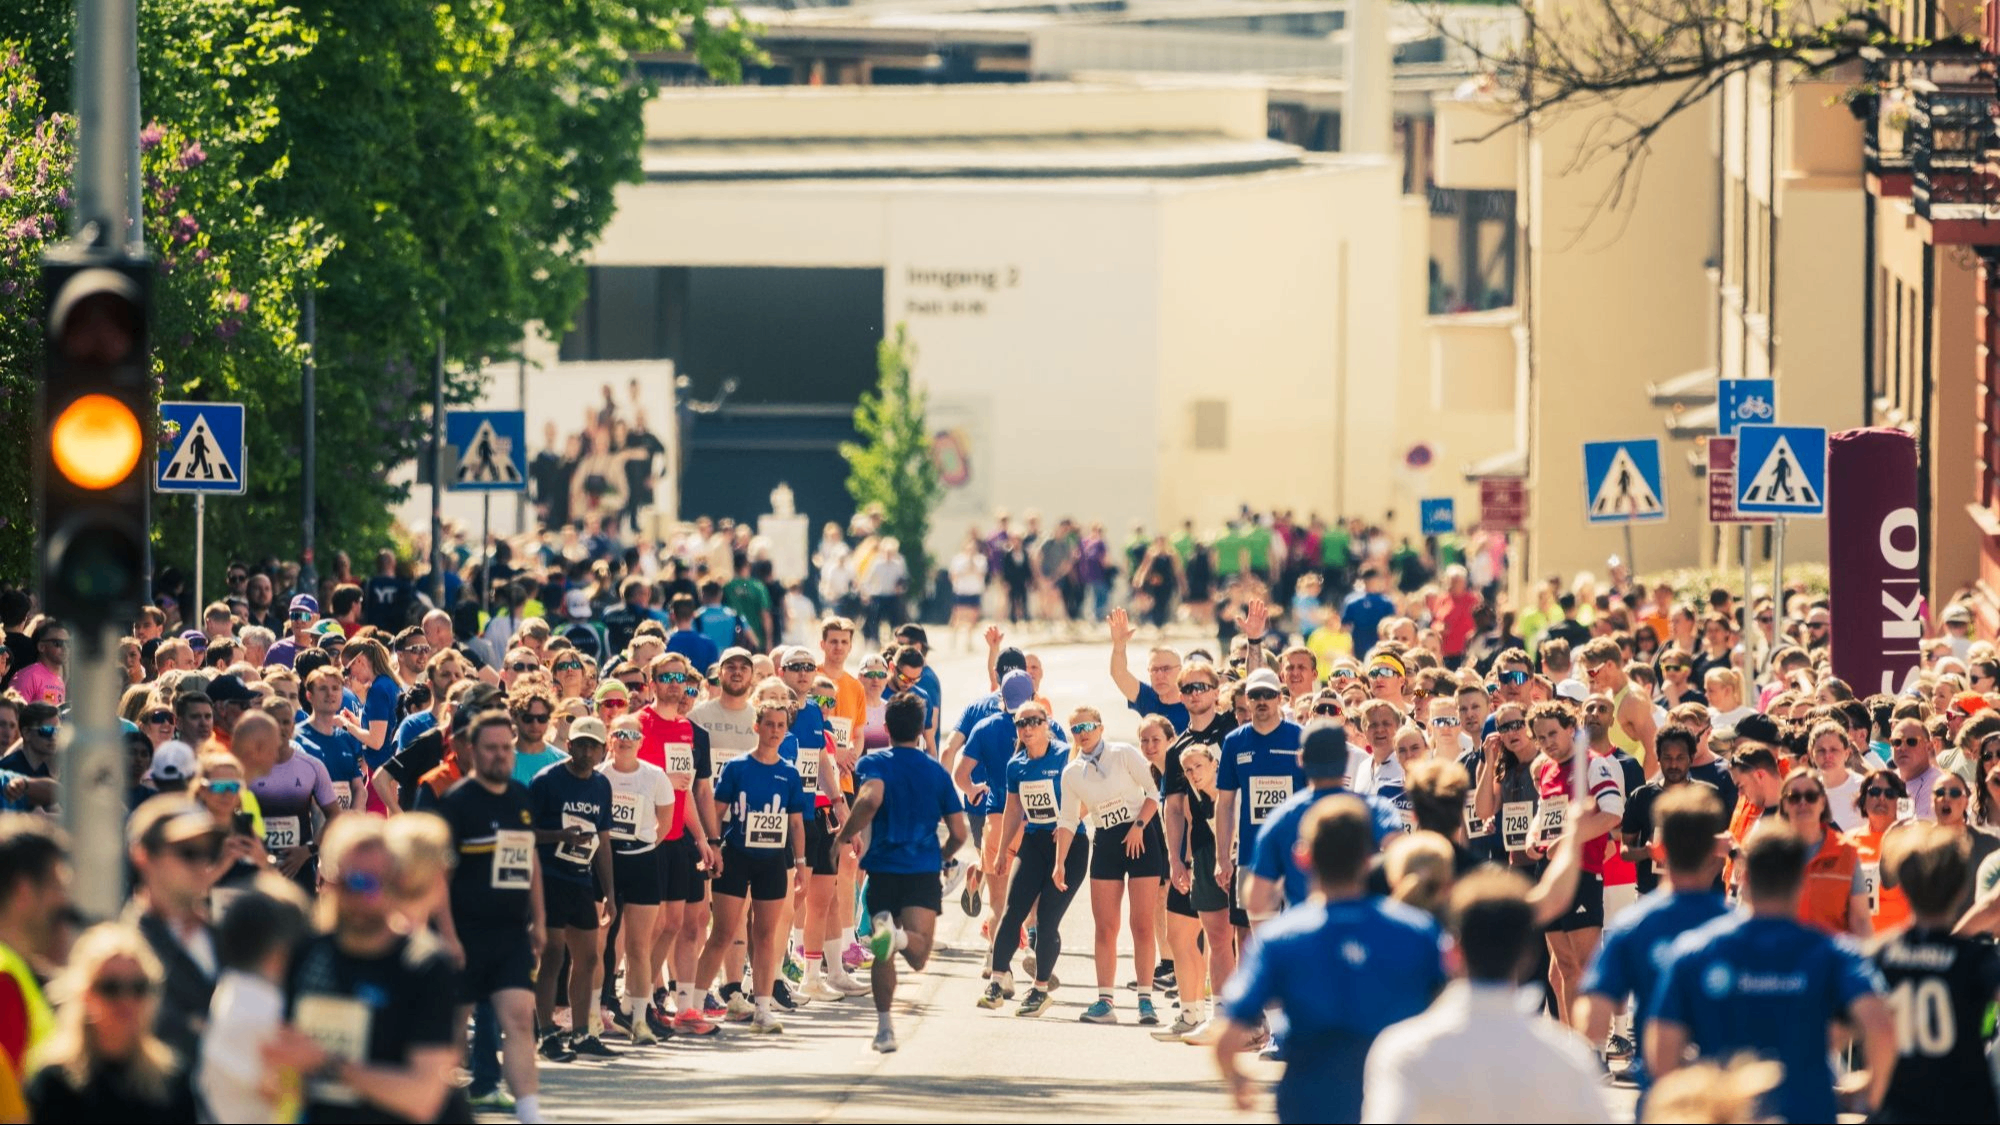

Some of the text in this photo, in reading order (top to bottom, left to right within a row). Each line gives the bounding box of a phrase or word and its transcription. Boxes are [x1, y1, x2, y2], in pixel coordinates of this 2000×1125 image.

[703, 722, 754, 735] REPLA
[670, 757, 691, 770] 7236
[1024, 792, 1051, 807] 7228
[1256, 790, 1287, 805] 7289
[563, 801, 601, 815] ALSTOM
[610, 804, 635, 820] 261
[753, 814, 782, 830] 7292
[1101, 806, 1131, 828] 7312
[1505, 816, 1529, 832] 7248
[265, 830, 294, 846] 7212
